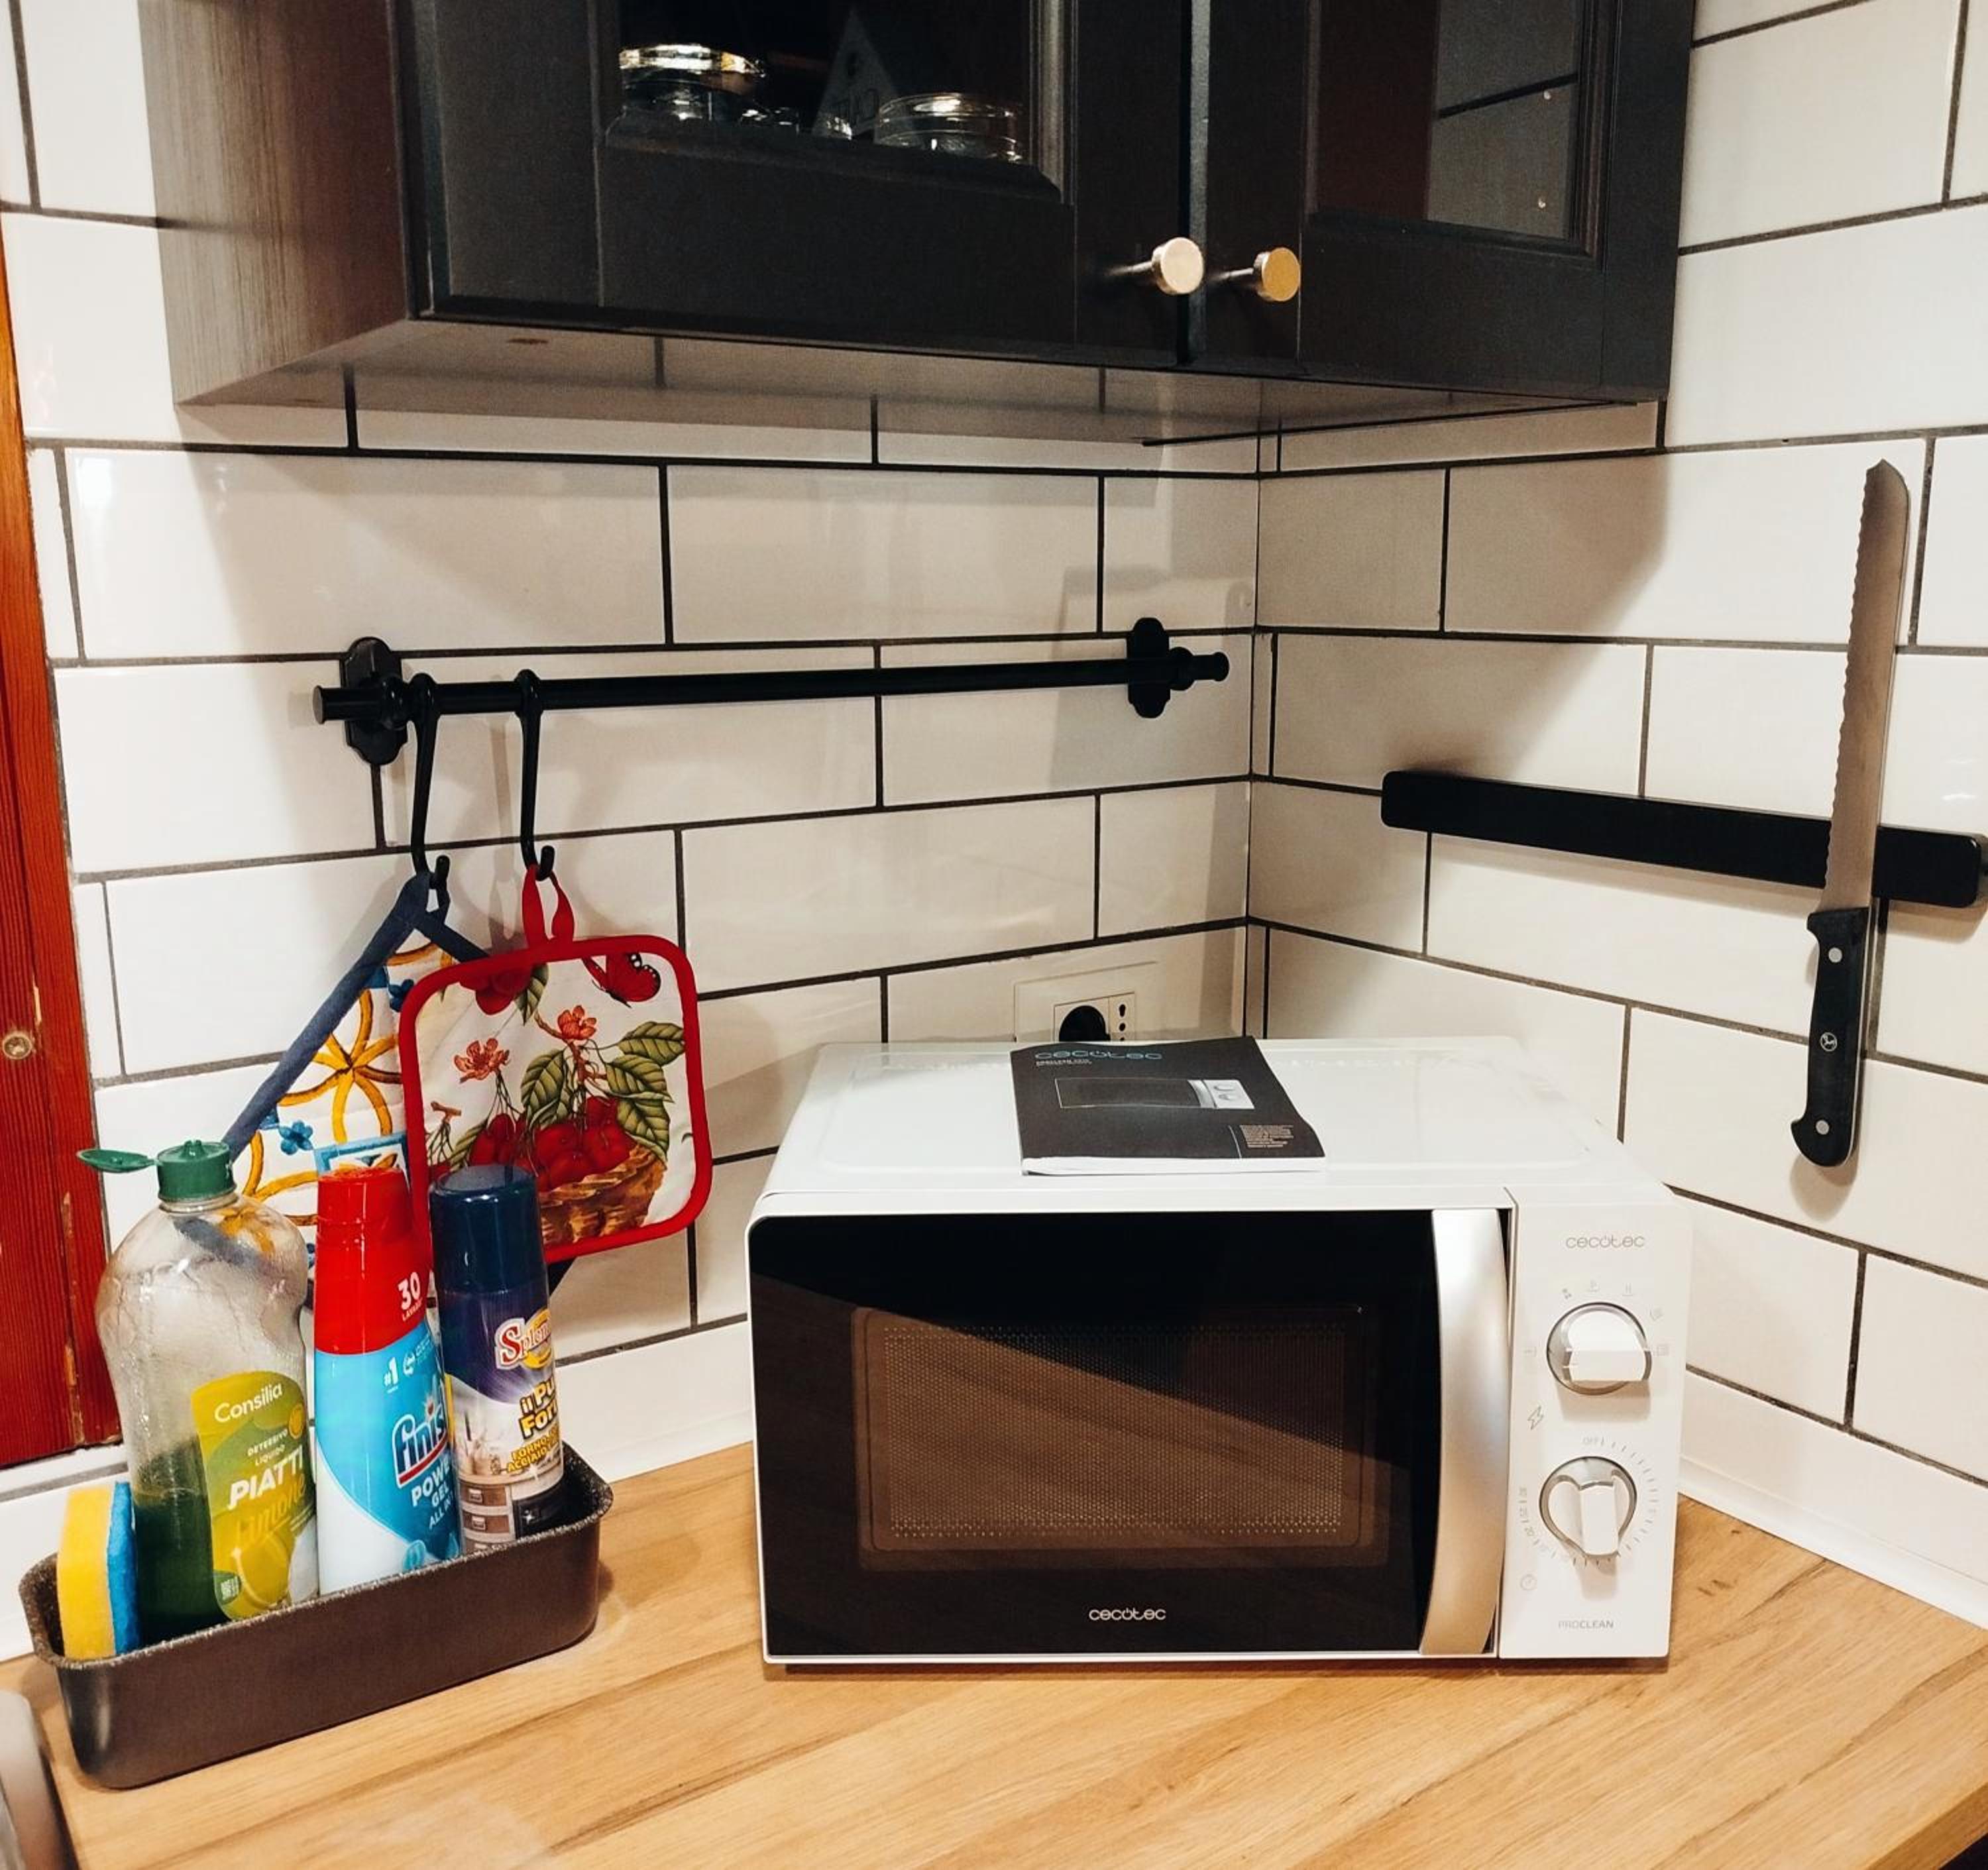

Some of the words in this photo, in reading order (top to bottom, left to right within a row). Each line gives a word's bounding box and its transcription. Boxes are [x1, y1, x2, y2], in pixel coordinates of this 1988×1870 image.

[398, 1271, 421, 1311] 30
[214, 1383, 283, 1423] Consilia
[520, 1396, 534, 1415] il
[533, 1376, 555, 1407] Pu
[393, 1403, 448, 1478] finis
[227, 1445, 303, 1510] PIATTI
[411, 1453, 451, 1508] POWE
[431, 1481, 449, 1508] GEL
[429, 1506, 445, 1530] ALL
[1089, 1607, 1166, 1620] cecotec
